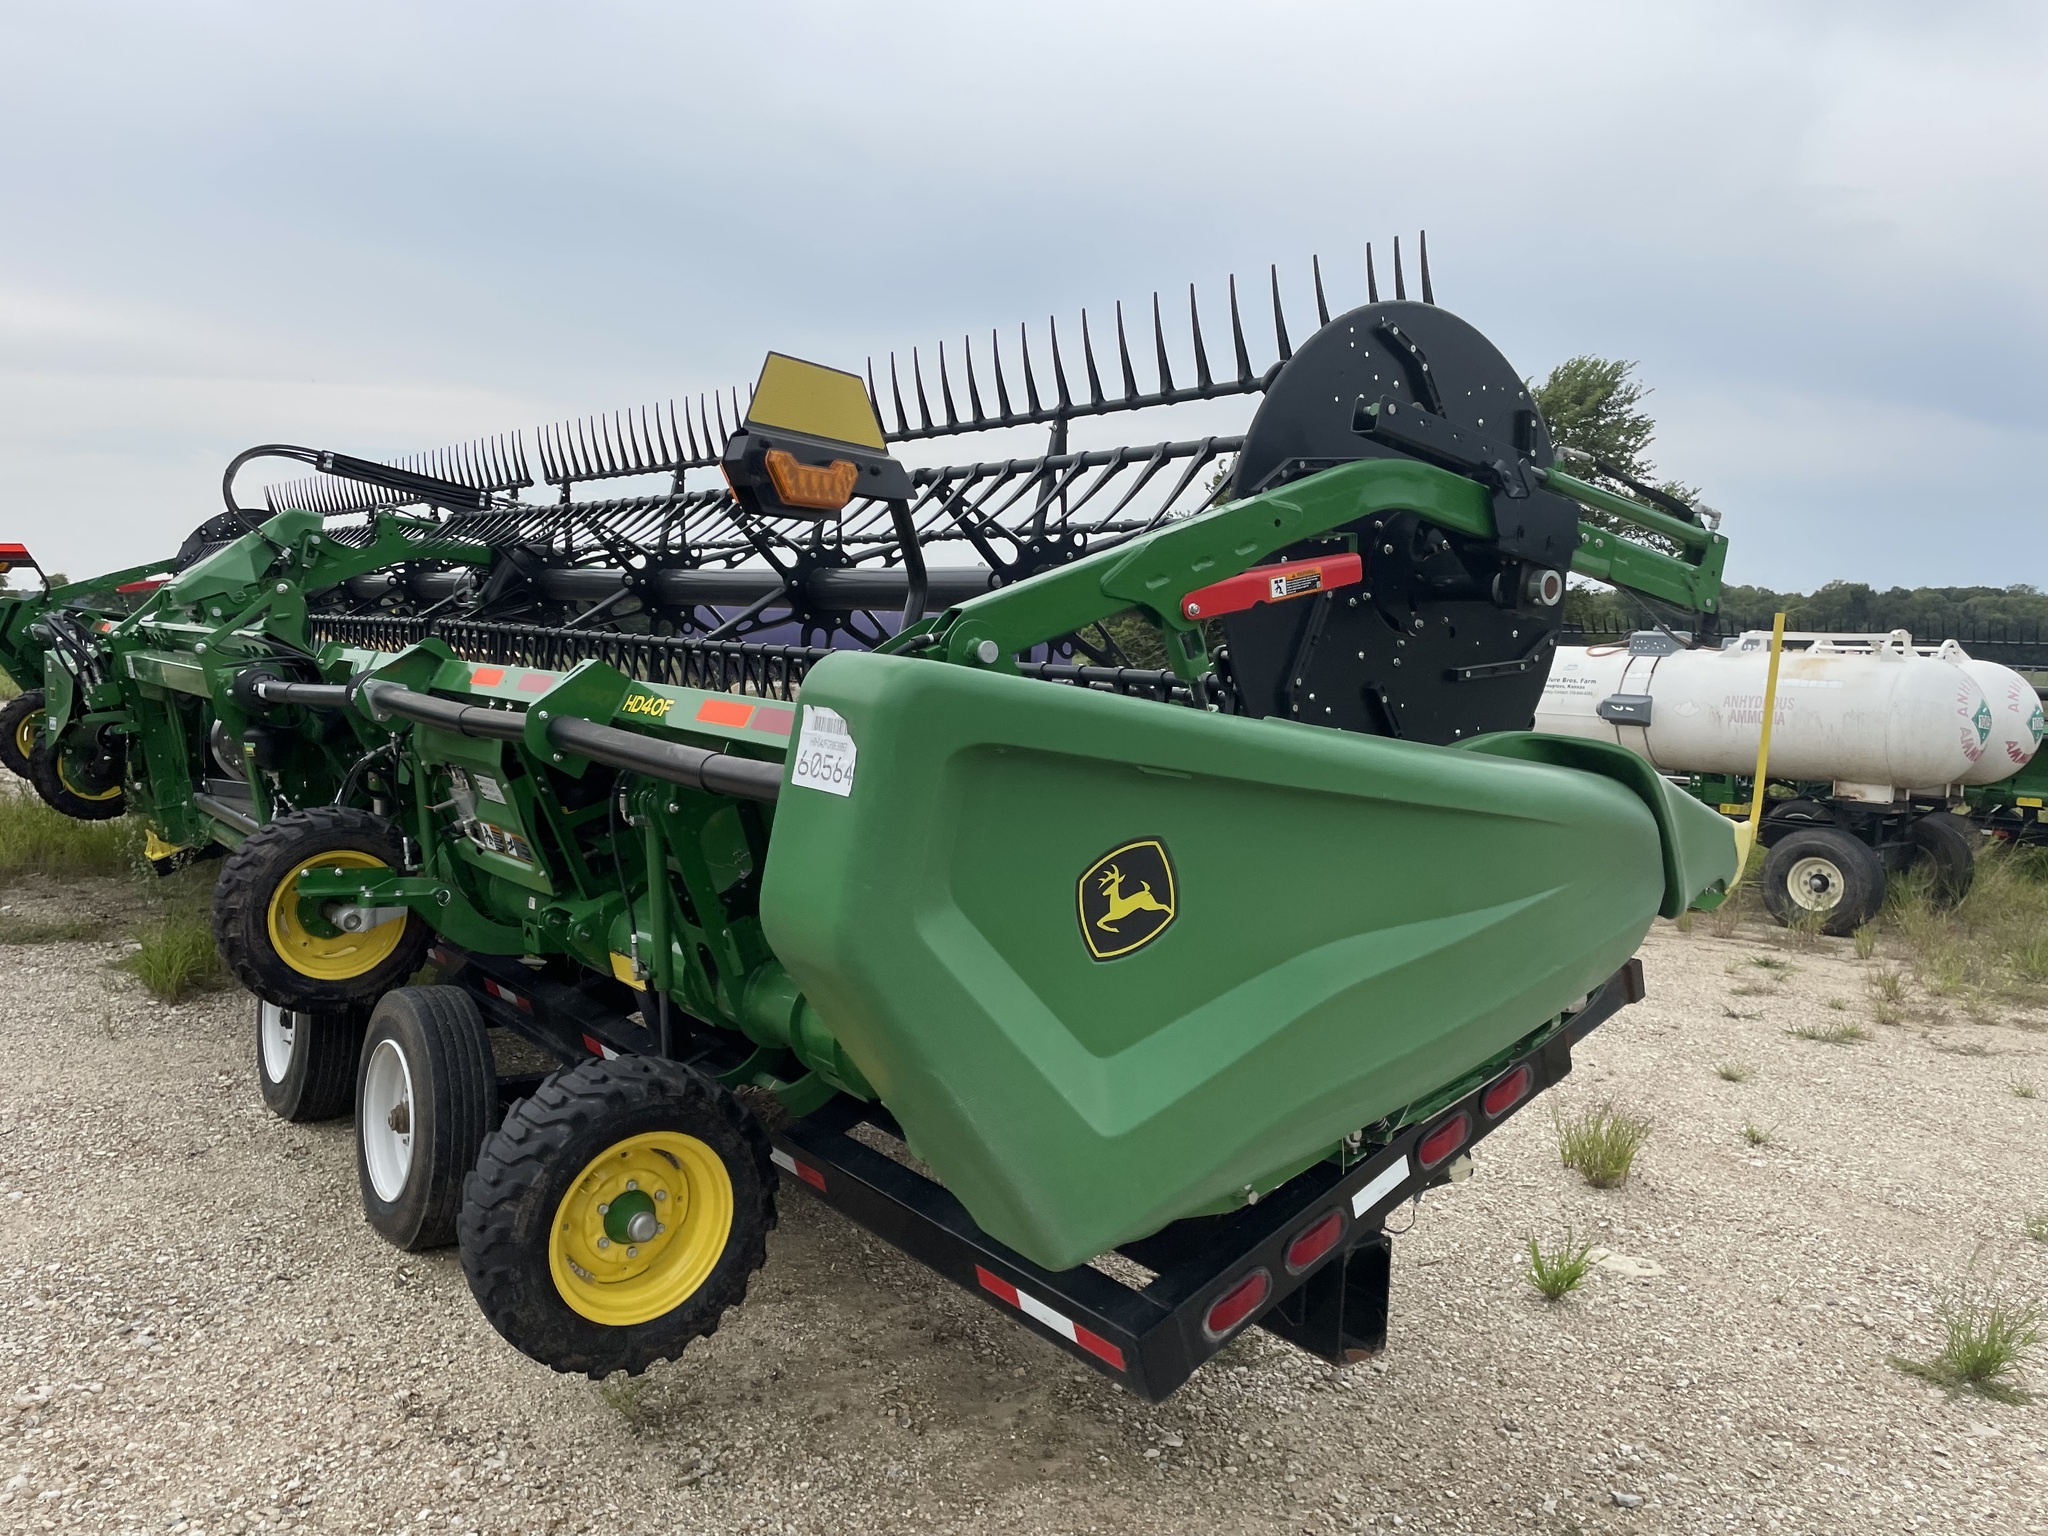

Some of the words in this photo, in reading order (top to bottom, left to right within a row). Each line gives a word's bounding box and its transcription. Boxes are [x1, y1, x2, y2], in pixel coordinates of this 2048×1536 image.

[622, 694, 676, 717] HD40F
[1723, 695, 1795, 711] ANHYDOUS
[1729, 710, 1785, 726] AMMOIA
[798, 750, 853, 786] 60564
